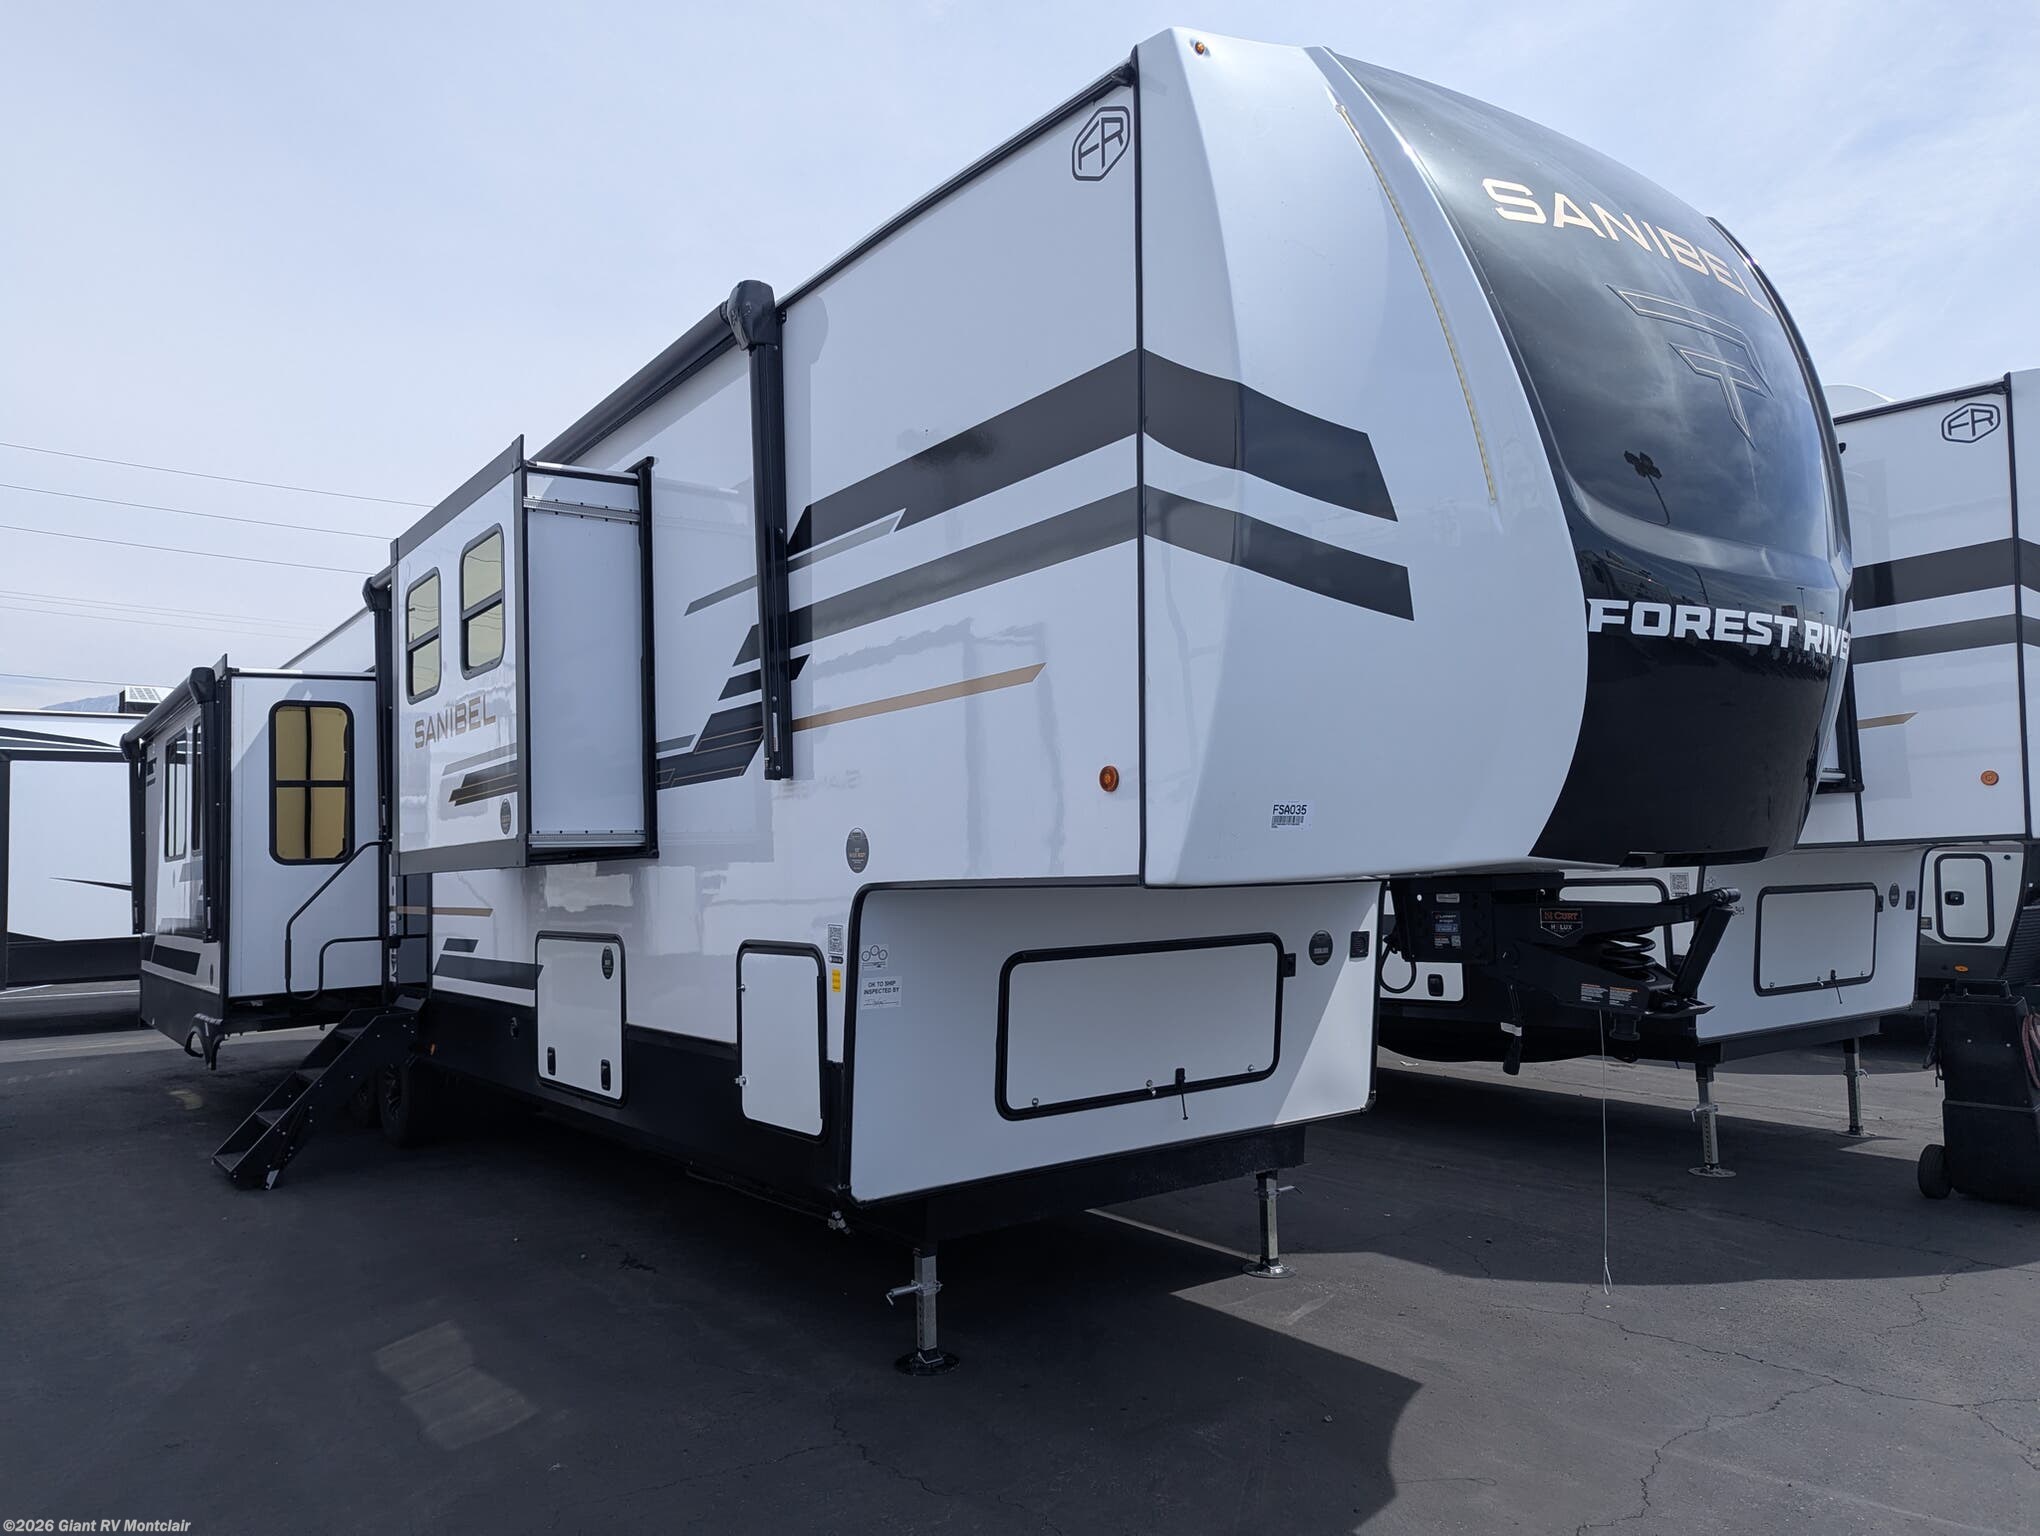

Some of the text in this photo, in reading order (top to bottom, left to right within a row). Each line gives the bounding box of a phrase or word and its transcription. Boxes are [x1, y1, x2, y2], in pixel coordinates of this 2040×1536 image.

[1482, 178, 1774, 318] SANIBEL
[1587, 598, 1851, 661] FOREST RIVE
[414, 694, 497, 749] SANIBEL
[1272, 804, 1308, 815] FSA035
[1554, 911, 1579, 920] CURT
